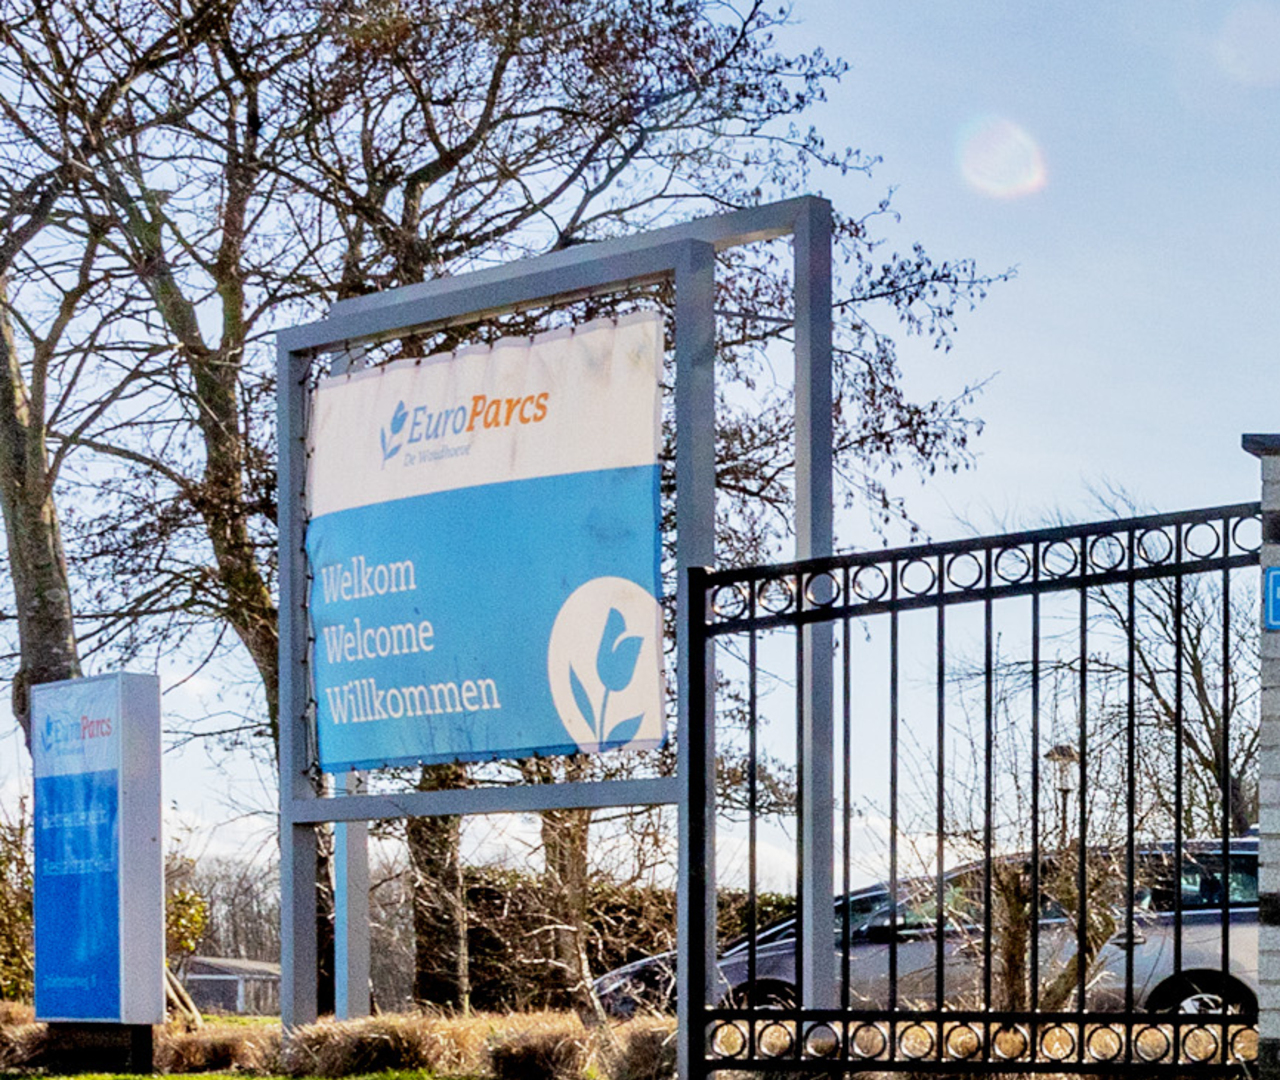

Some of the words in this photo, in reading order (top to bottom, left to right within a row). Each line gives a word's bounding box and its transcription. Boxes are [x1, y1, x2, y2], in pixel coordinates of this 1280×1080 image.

[407, 392, 549, 444] EuroParcs
[322, 555, 417, 604] Welkom
[323, 617, 434, 664] Welcome
[325, 678, 501, 725] Willkommen
